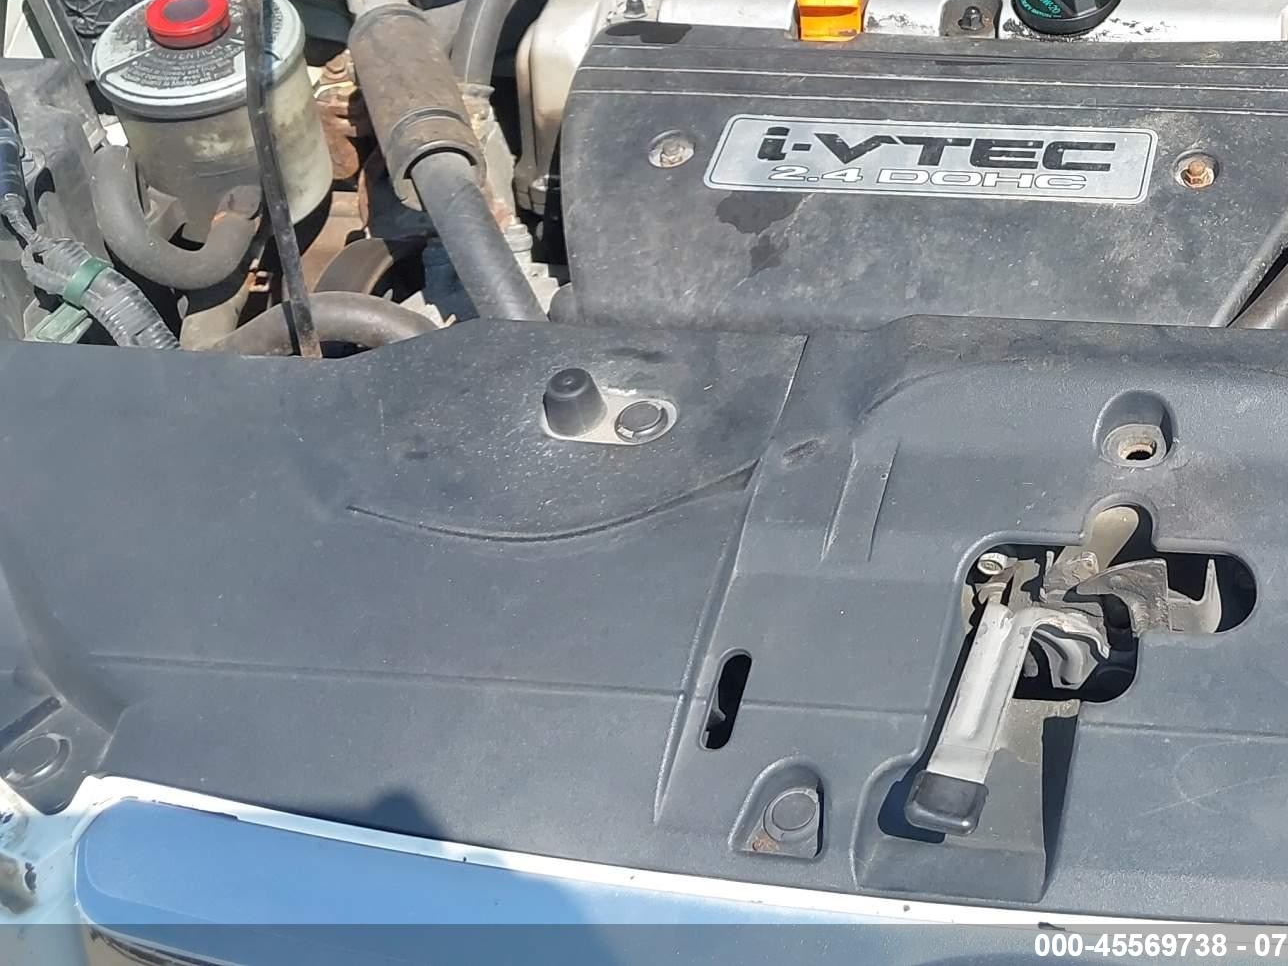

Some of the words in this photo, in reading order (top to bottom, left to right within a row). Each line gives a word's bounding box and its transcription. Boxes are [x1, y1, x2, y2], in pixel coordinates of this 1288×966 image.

[756, 125, 1116, 172] i-VTEC
[768, 165, 863, 183] 2.4
[875, 167, 1089, 191] DOHC
